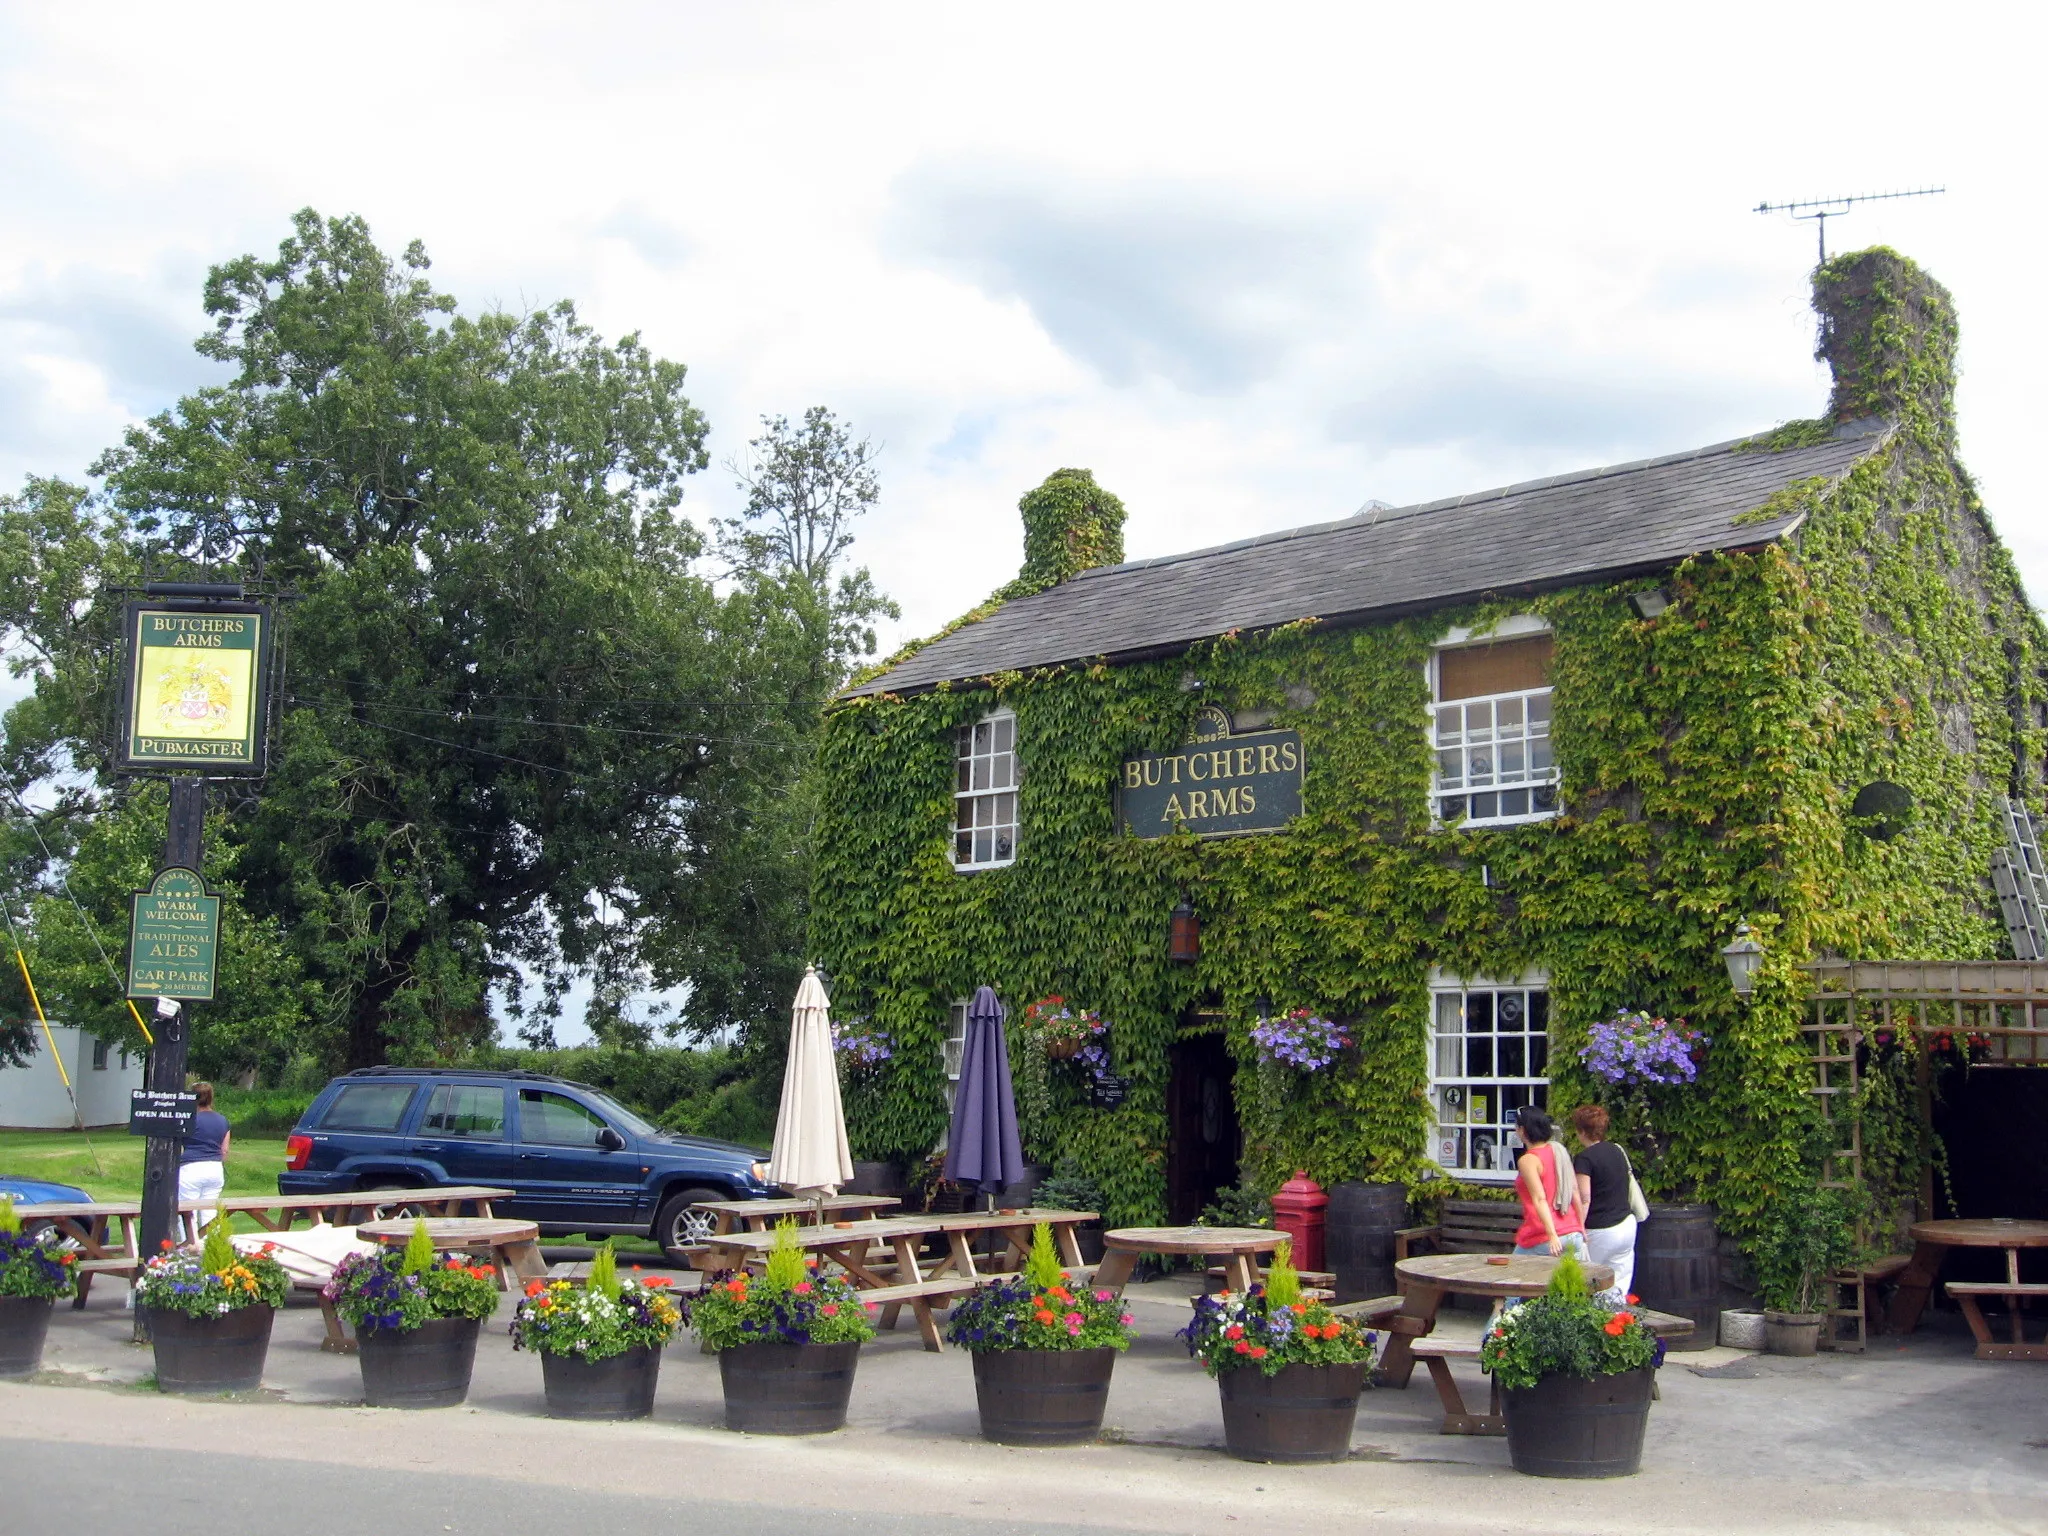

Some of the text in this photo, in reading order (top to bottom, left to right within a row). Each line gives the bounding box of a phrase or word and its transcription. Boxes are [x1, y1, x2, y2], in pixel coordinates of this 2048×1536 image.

[154, 618, 244, 633] BUTCHERS
[174, 634, 222, 647] ARMS
[140, 739, 244, 756] PUBMASTER
[1124, 742, 1298, 789] BUTCHERS
[1161, 785, 1256, 822] ARMS
[157, 873, 200, 897] PUBMASTER
[157, 901, 197, 911] WARM
[145, 911, 208, 922] WELCOME
[138, 932, 212, 943] TRADITIONAL
[150, 944, 199, 958] ALES
[135, 970, 208, 982] CAR PARK
[174, 983, 206, 991] METRES
[133, 1090, 197, 1100] The Butchers Arms
[135, 1110, 157, 1118] OPEN
[175, 1111, 192, 1119] DAY
